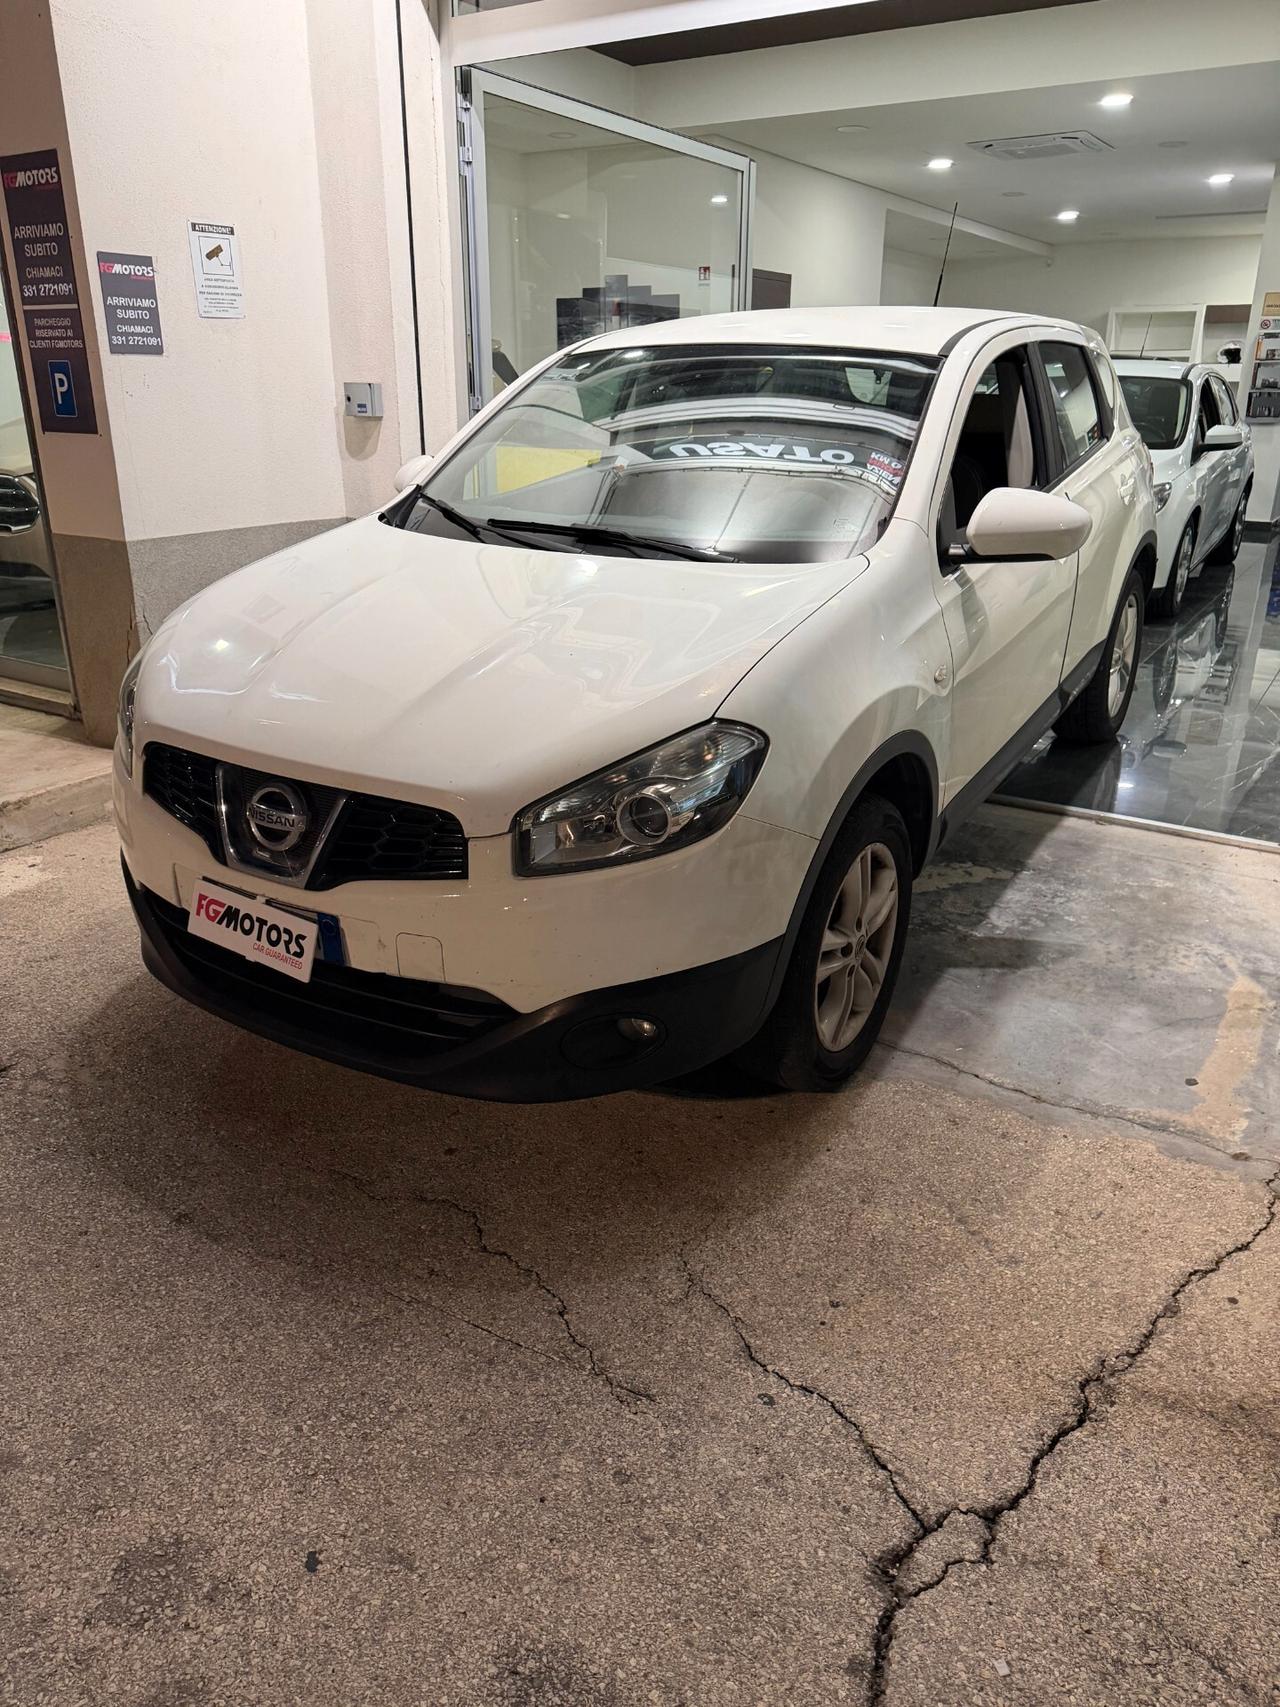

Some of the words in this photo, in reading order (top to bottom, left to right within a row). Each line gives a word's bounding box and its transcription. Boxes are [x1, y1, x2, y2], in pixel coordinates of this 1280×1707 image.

[4, 167, 59, 188] FGMOTORS
[14, 223, 64, 239] ARRIVIAMO
[25, 242, 58, 256] SUBITO
[26, 266, 63, 278] CHIAMACI
[100, 262, 153, 277] FGMOTORS
[23, 285, 37, 297] 331
[39, 283, 73, 296] 2721091
[107, 296, 156, 308] ARRIVIAMO
[116, 309, 150, 320] SUBITO
[34, 318, 71, 326] PARCHEGGIO
[116, 324, 153, 334] CHIAMACI
[35, 329, 66, 337] RISERVATO
[111, 336, 126, 345] 331
[128, 336, 162, 346] 2721091
[54, 373, 68, 404] P
[249, 807, 295, 828] NISSAN
[195, 893, 307, 959] FGMOTORS
[253, 942, 265, 955] CAR
[265, 948, 303, 970] GUARANTEED
